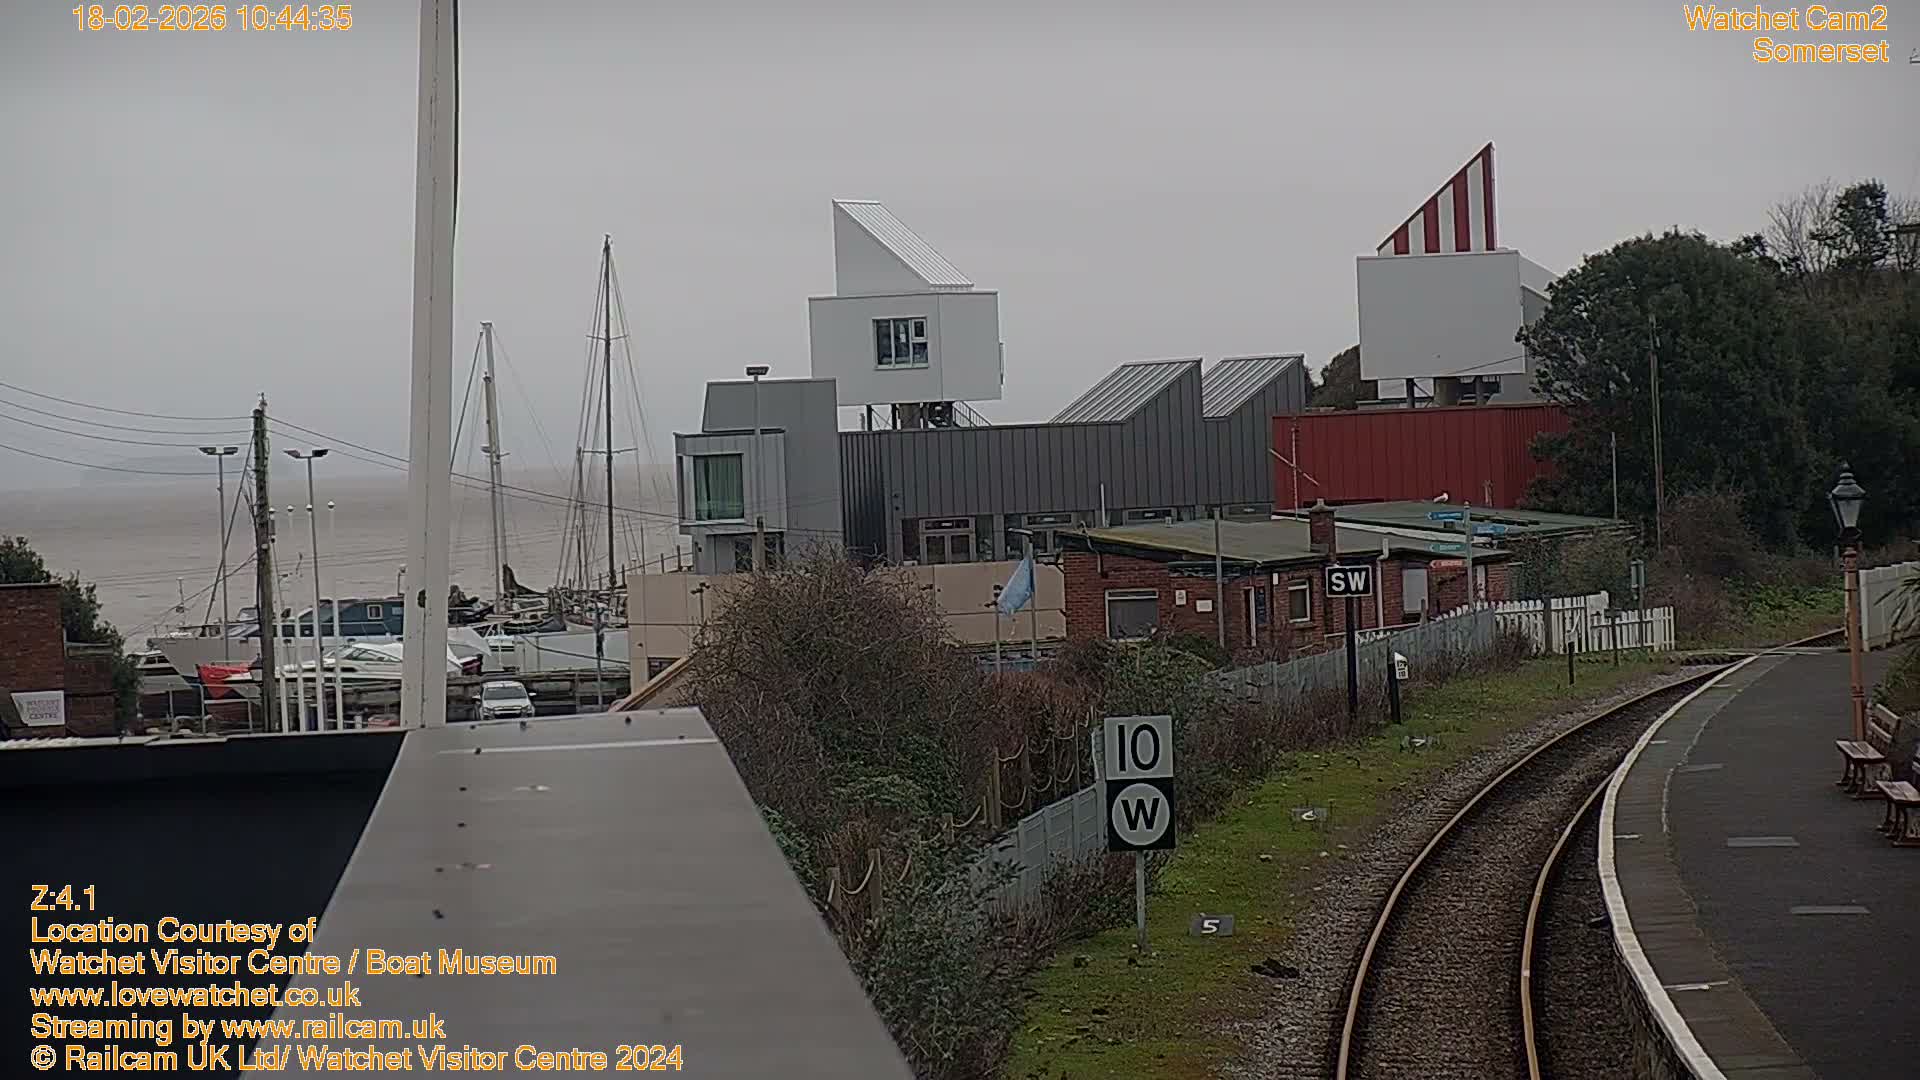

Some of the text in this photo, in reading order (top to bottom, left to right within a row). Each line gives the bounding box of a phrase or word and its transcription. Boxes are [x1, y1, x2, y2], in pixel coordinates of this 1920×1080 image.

[1331, 571, 1366, 592] SW
[1117, 723, 1160, 772] 10
[1121, 797, 1160, 831] W
[1201, 919, 1220, 934] 5
